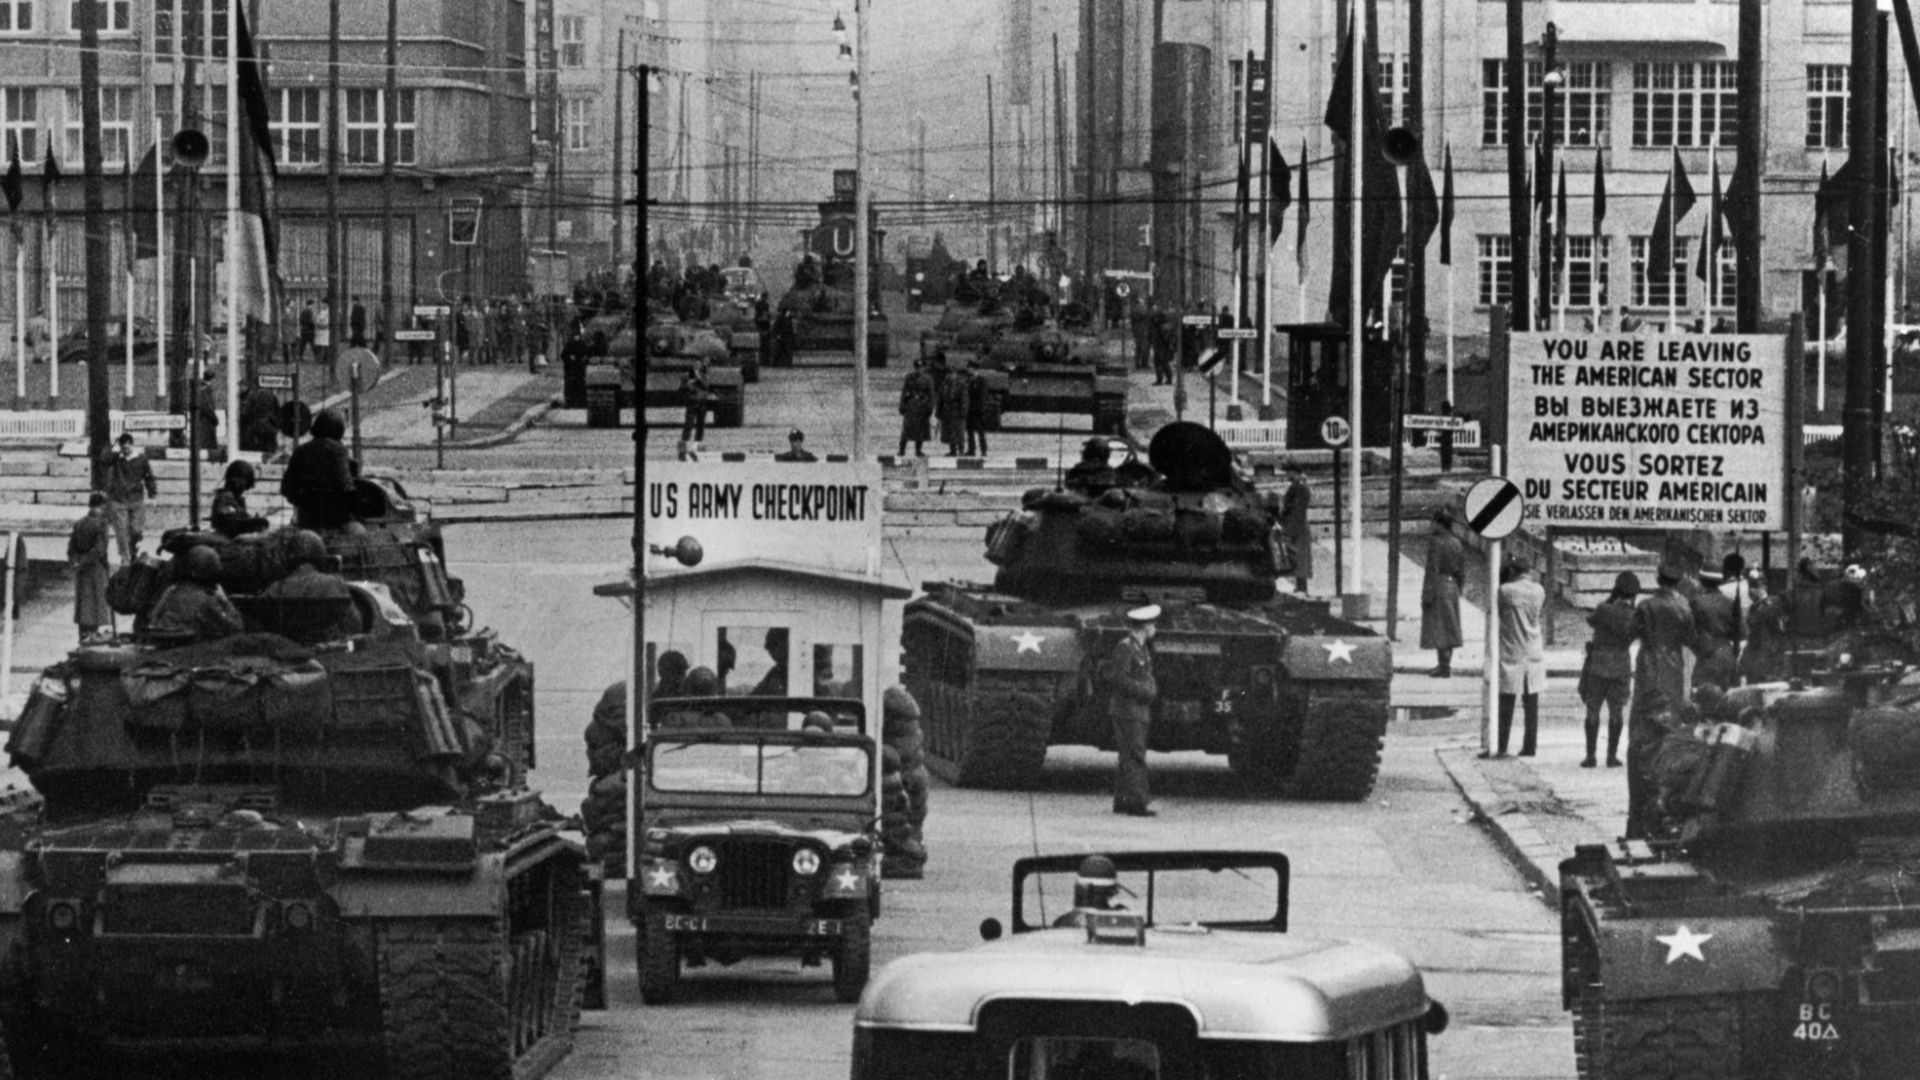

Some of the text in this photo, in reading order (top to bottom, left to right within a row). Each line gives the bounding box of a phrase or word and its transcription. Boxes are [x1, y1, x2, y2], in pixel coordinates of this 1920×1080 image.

[833, 226, 854, 255] U
[1543, 339, 1752, 363] YOU ARE LEAVING
[1531, 365, 1763, 389] THE AMERICAN SECTOR
[1534, 396, 1760, 420] ВЫ ВЫЕЗЖАЕТЕ ИЗ
[1326, 420, 1340, 441] 10
[1529, 421, 1765, 445] АМЕРИКАНСКОГО СЕКТОРА
[1564, 453, 1724, 477] VOUS SORTEZ
[689, 482, 743, 519] ARMY
[752, 483, 868, 522] CHECKPOINT
[1525, 478, 1768, 503] DU SECTEUR AMERICAIN
[1524, 503, 1767, 524] SIE VERLASSEN DEN AMERIKANISCHEN SEKTOR
